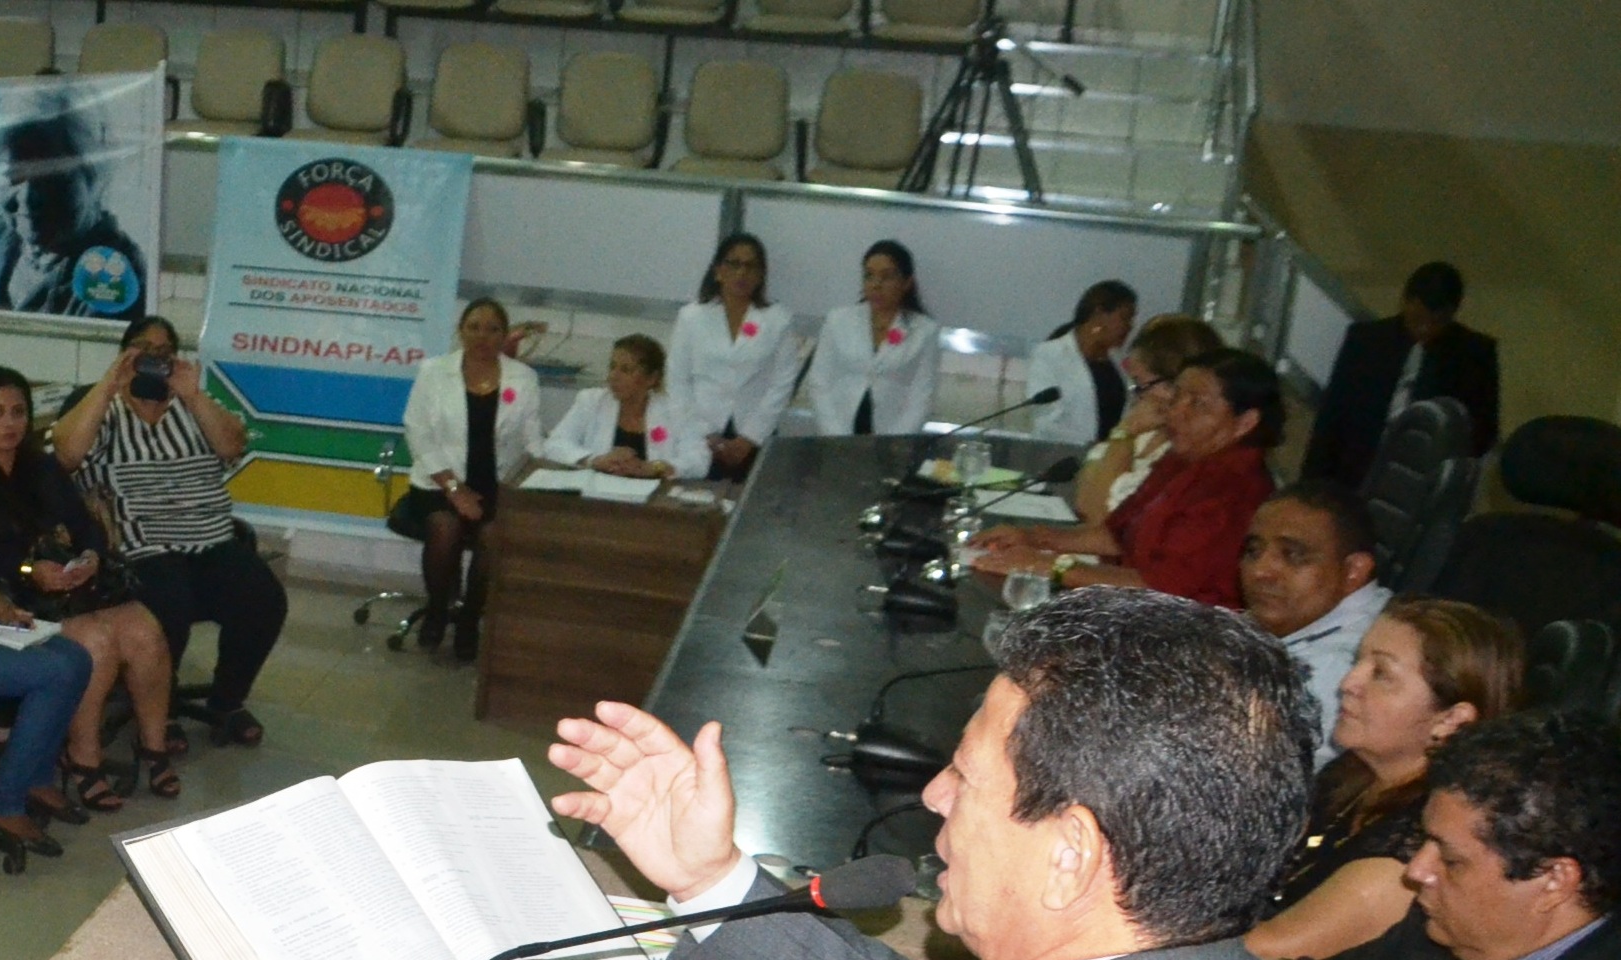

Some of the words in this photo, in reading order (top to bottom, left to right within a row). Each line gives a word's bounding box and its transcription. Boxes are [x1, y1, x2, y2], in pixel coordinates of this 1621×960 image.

[298, 161, 374, 194] FORÇA
[279, 217, 386, 259] SINDICAL
[241, 273, 332, 293] SINDICATO
[335, 281, 424, 300] NACIONAL
[249, 288, 286, 303] DOS
[289, 291, 420, 314] APOSENTADOS
[230, 331, 425, 366] SINDNAPI-AP
